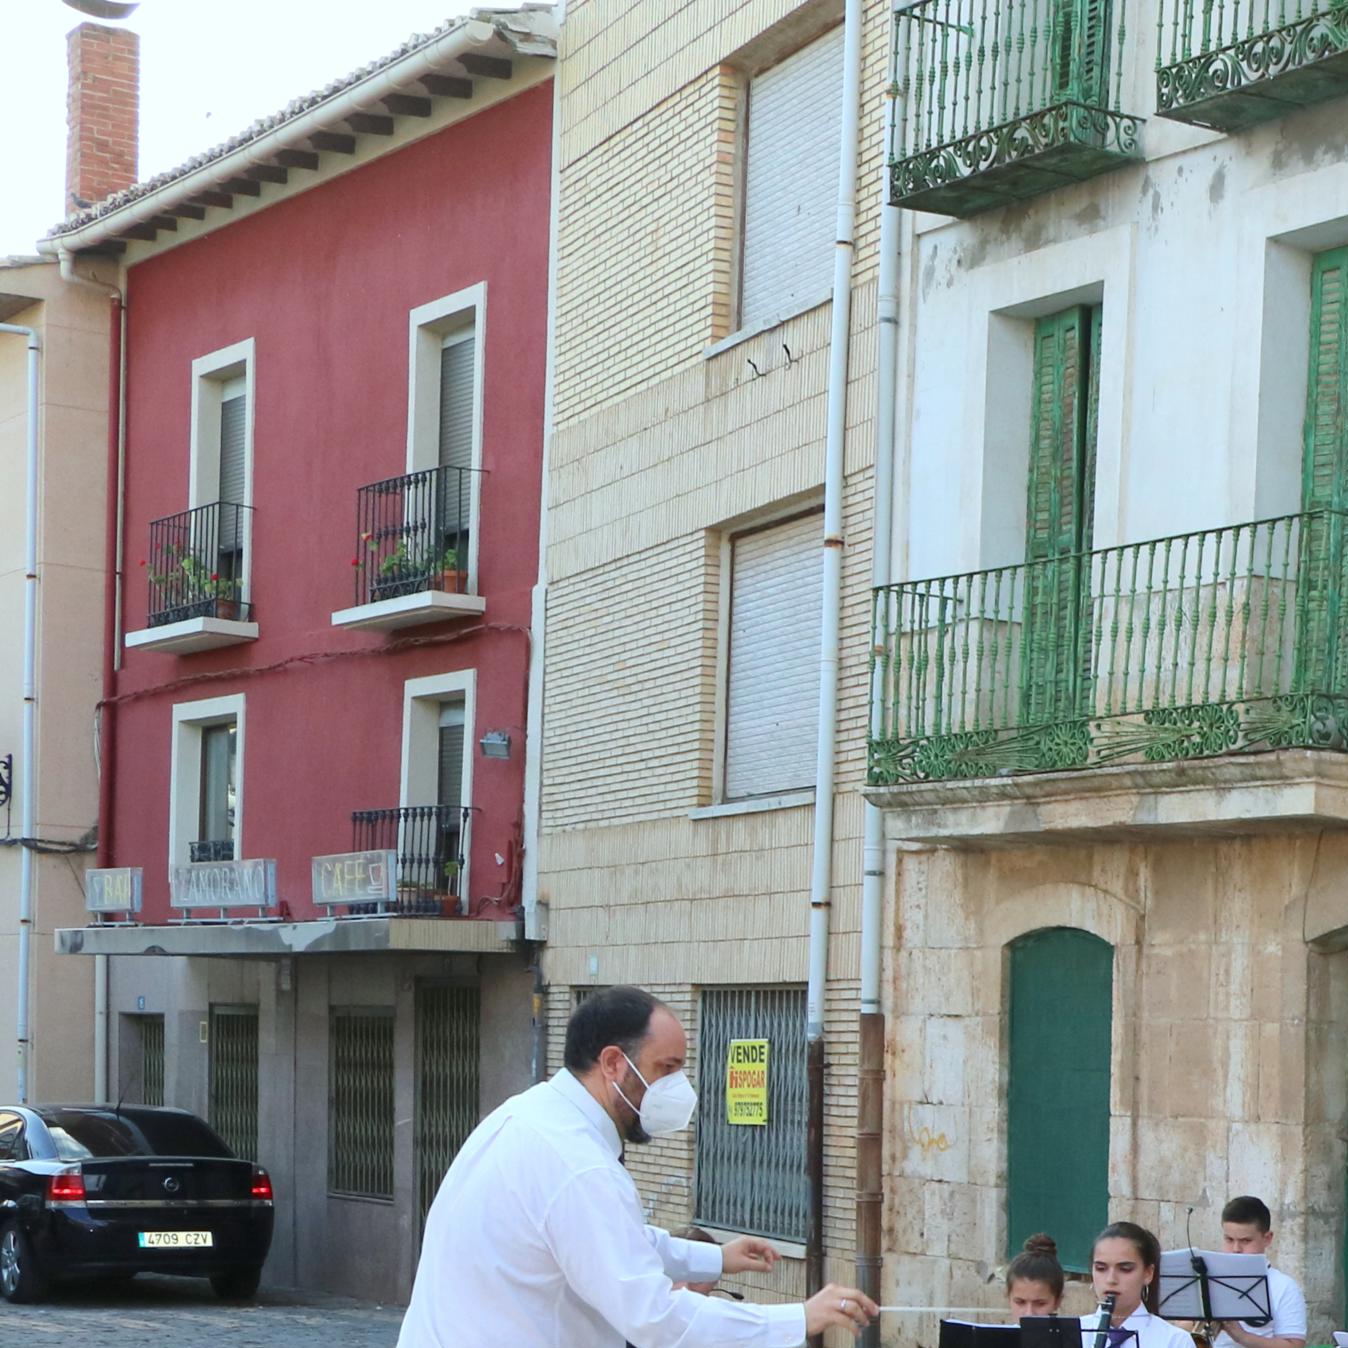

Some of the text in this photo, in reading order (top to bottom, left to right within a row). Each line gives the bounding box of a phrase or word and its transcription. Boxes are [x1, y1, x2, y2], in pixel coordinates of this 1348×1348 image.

[730, 1045, 765, 1064] VENDE
[148, 1233, 208, 1245] 4709 CZV
